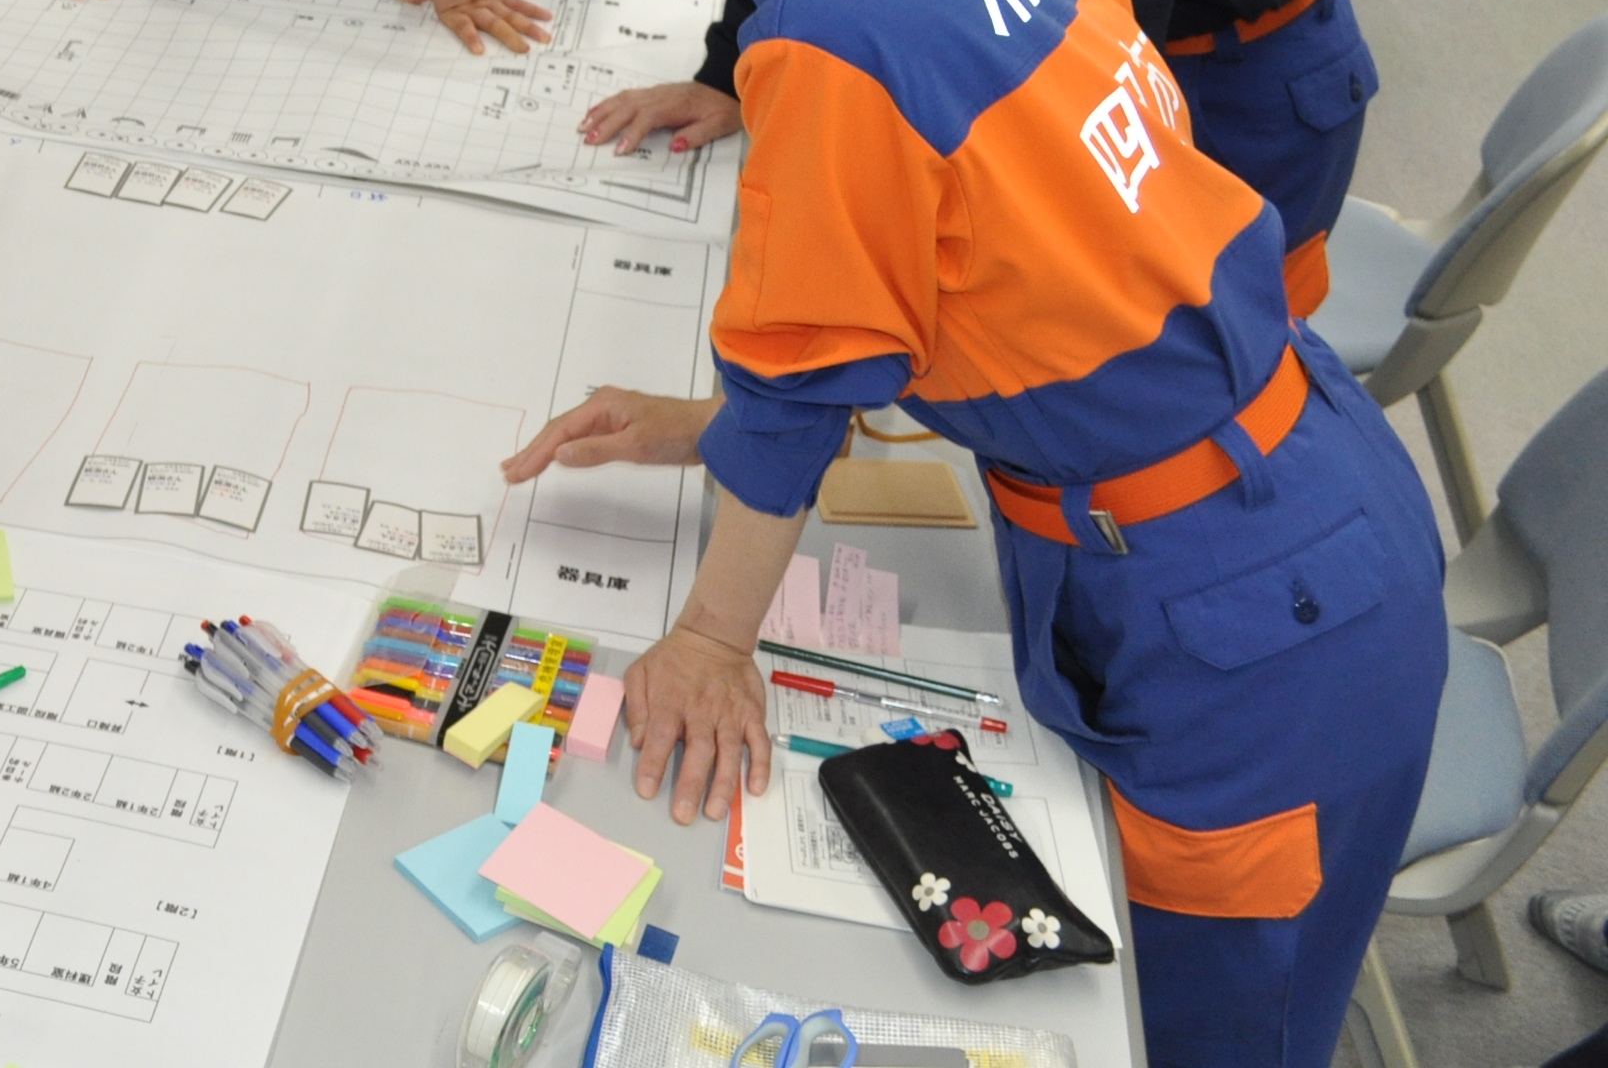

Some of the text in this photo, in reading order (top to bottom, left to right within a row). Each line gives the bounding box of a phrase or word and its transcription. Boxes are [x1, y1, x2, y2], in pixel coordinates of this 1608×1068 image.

[557, 564, 631, 592] 器具庫
[48, 783, 92, 802] 2年2組
[115, 799, 160, 818] 2年1組
[170, 798, 188, 819] 階段
[953, 775, 1020, 859] MARC JACOBS
[980, 792, 1023, 843] DAISY
[7, 872, 53, 892] 4年1組
[51, 966, 93, 986] 理科室
[104, 962, 123, 987] 階段
[130, 974, 148, 997] 女子
[146, 968, 164, 1001] トイレ
